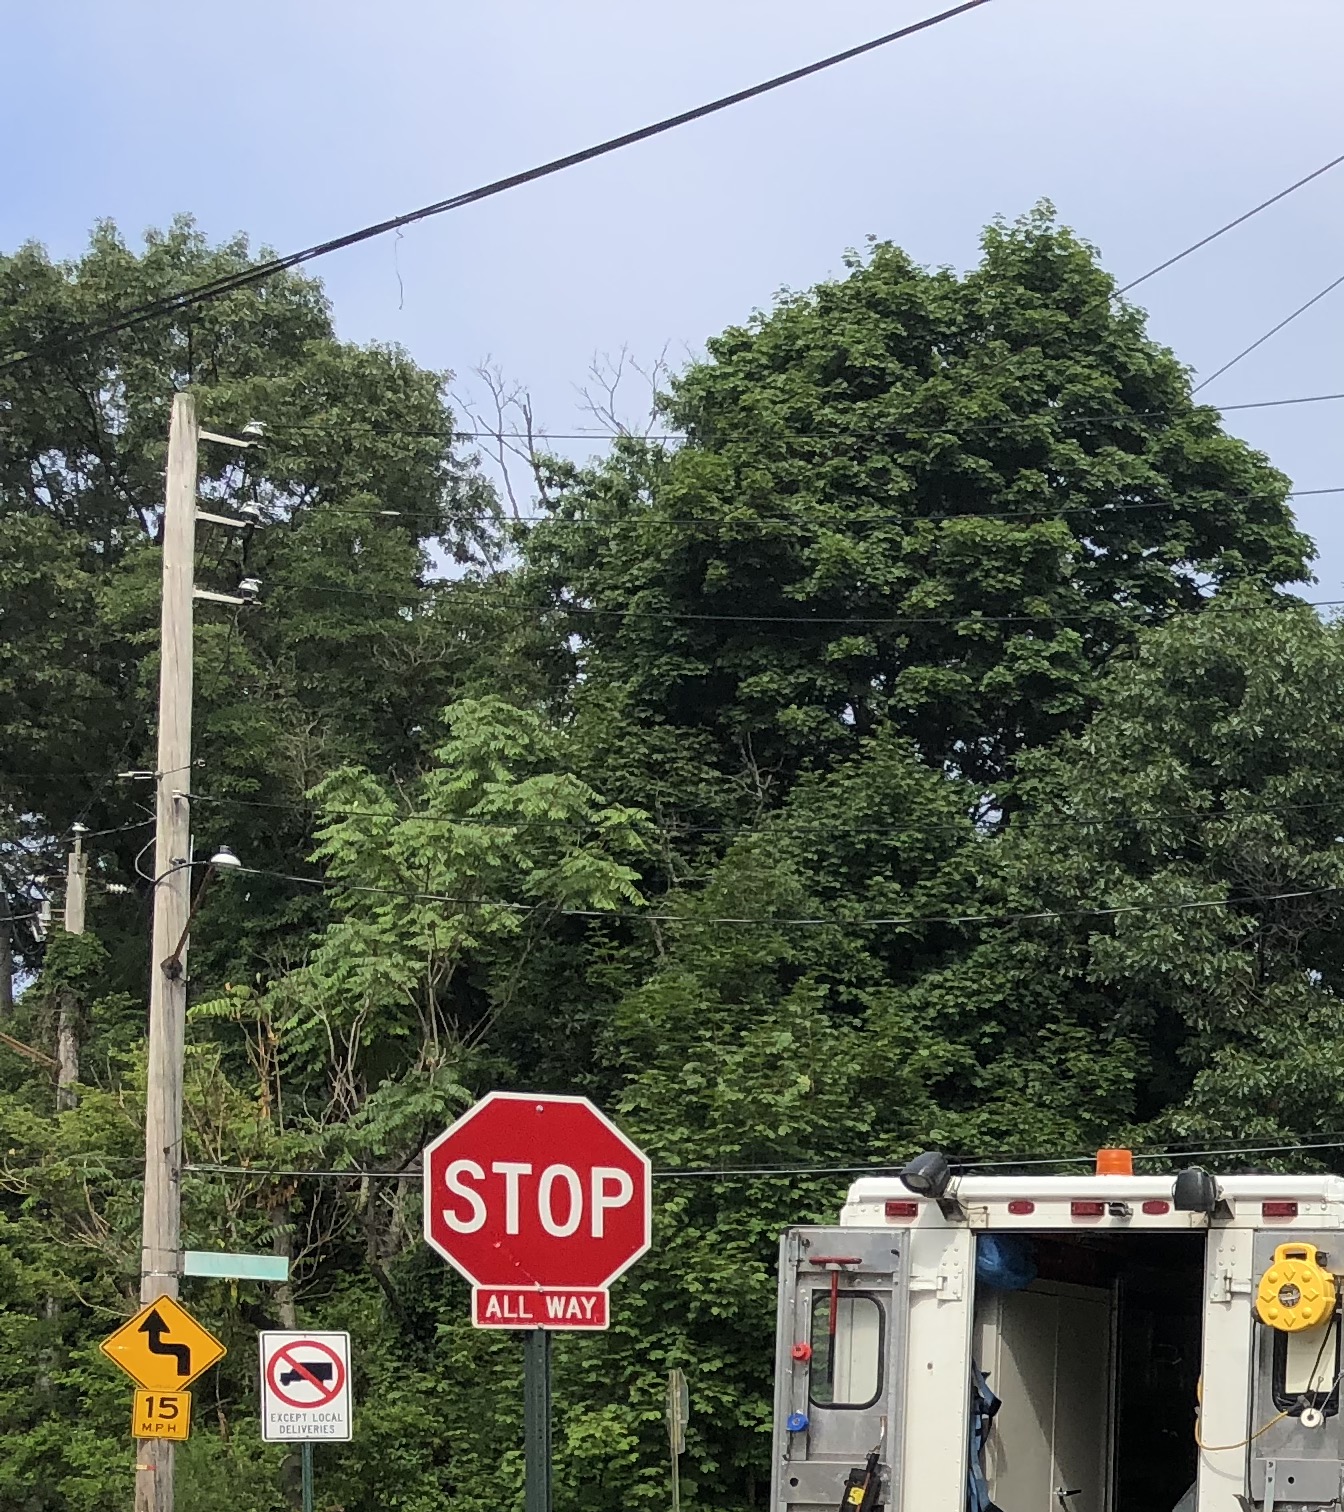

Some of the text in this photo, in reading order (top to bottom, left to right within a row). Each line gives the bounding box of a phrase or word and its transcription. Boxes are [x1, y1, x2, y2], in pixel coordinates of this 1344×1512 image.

[442, 1159, 634, 1239] STOP
[485, 1294, 597, 1319] ALL WAY
[145, 1396, 179, 1420] 15
[270, 1413, 343, 1423] EXCEPT LOCAL
[279, 1424, 335, 1434] DELIVERIES
